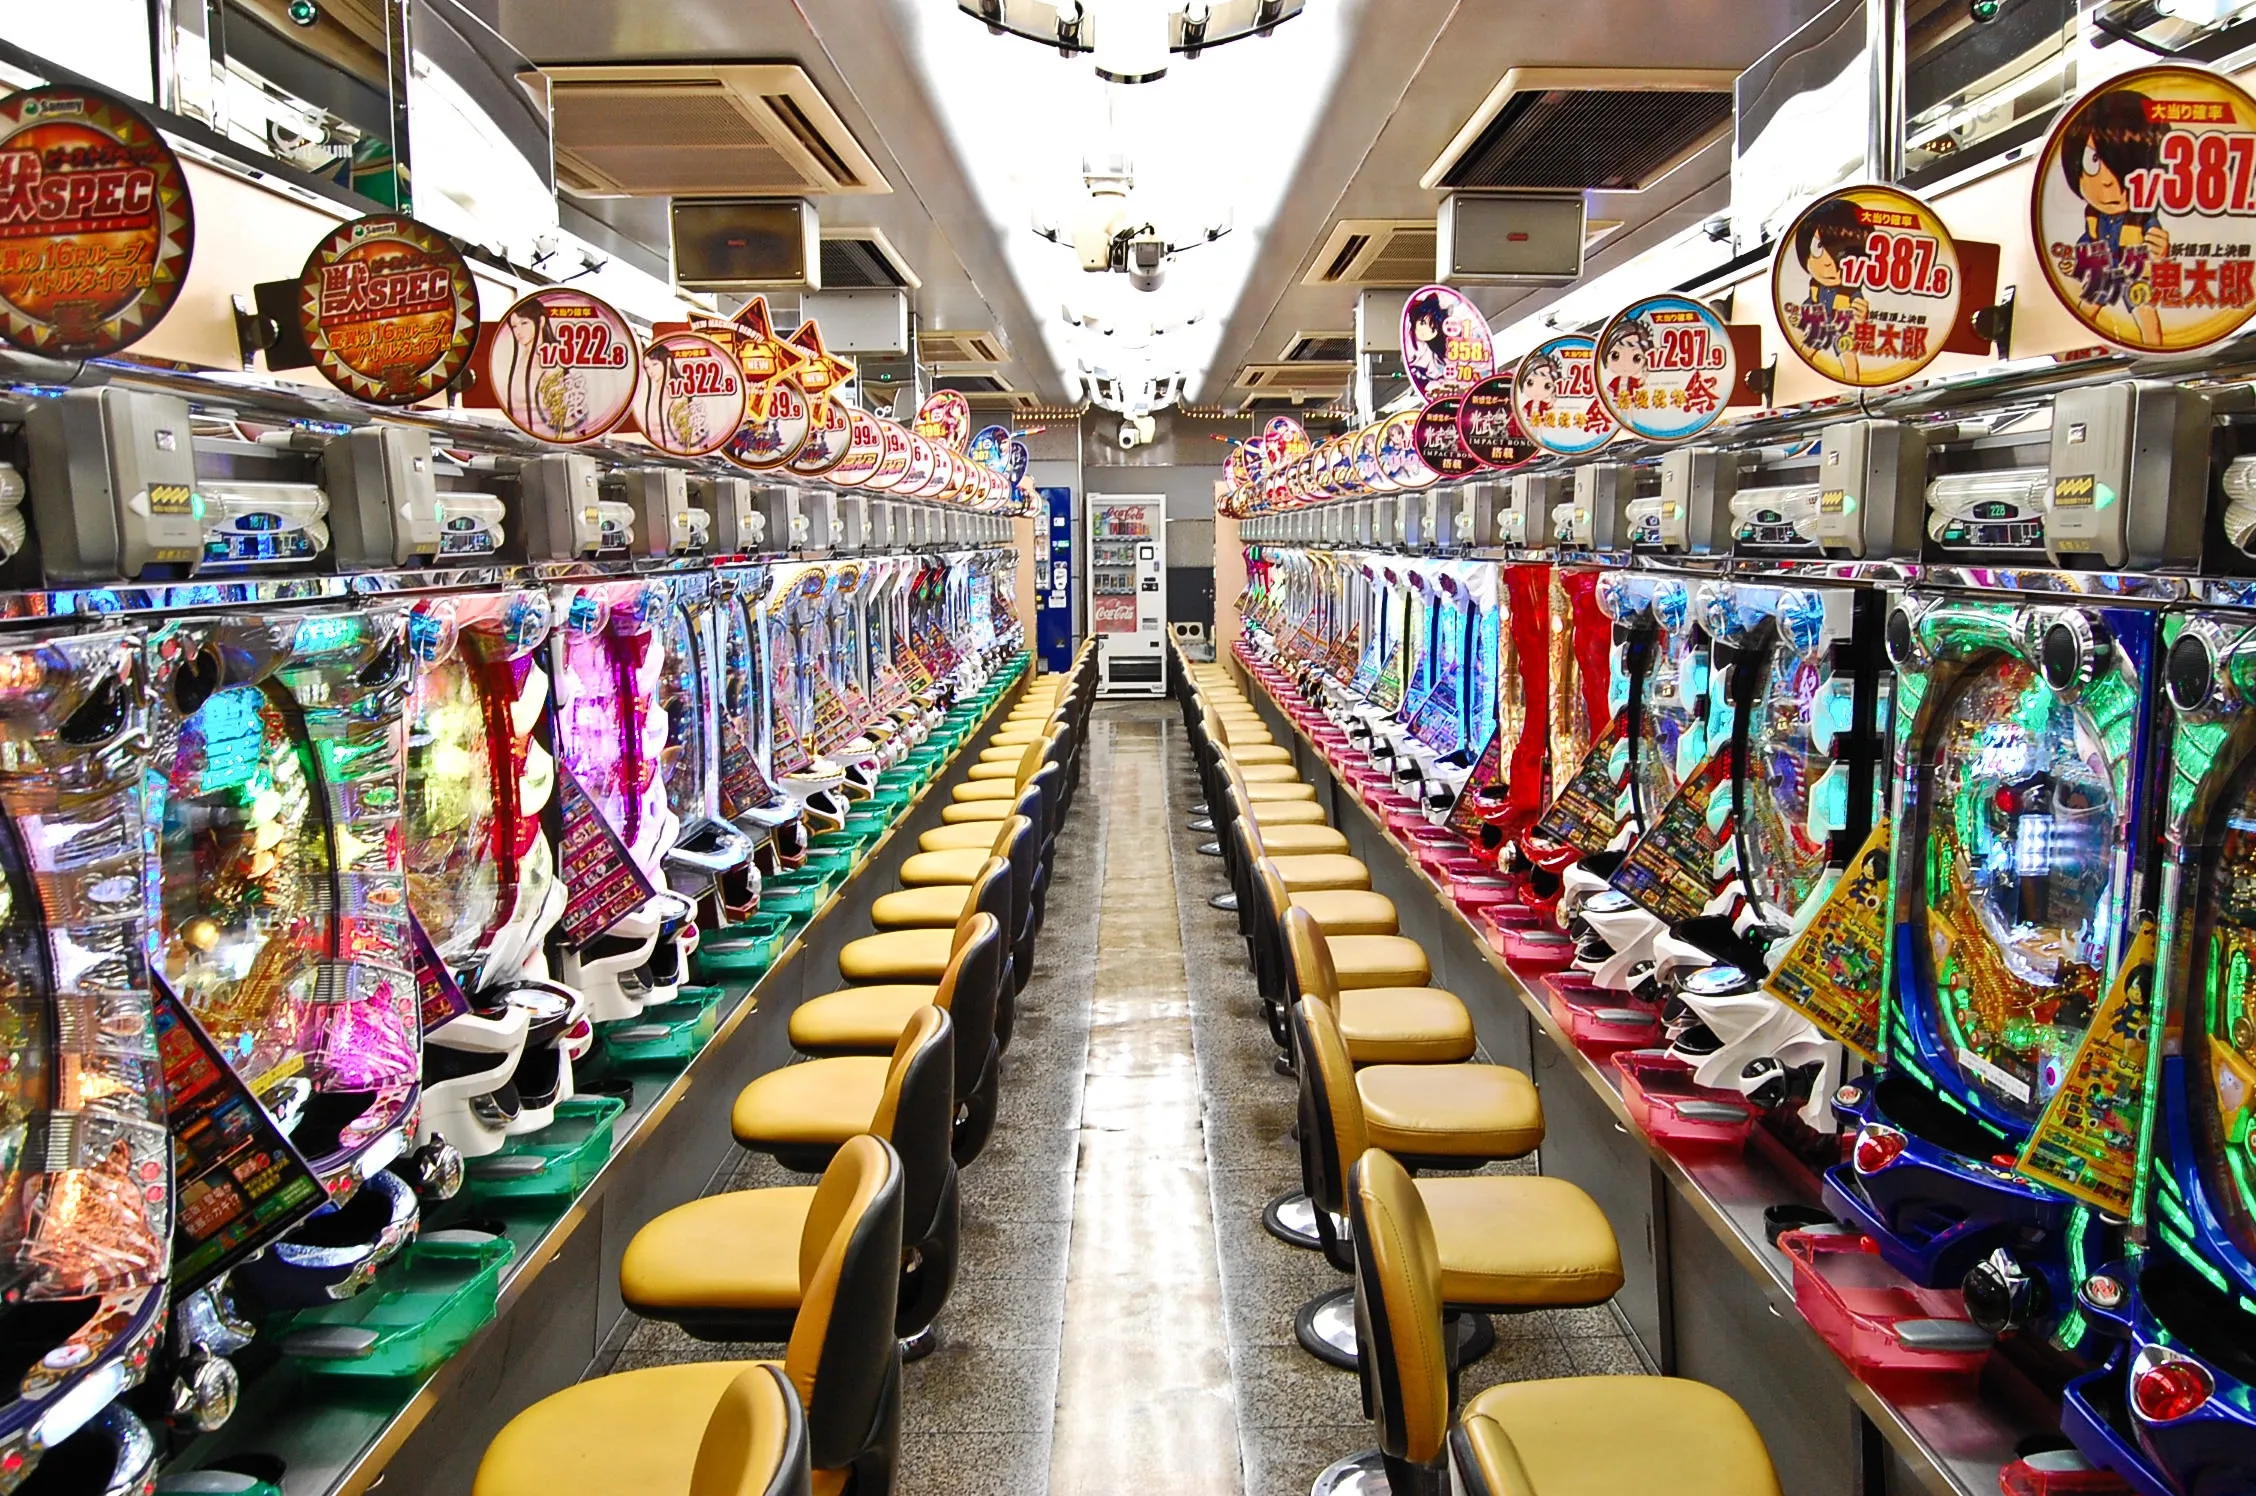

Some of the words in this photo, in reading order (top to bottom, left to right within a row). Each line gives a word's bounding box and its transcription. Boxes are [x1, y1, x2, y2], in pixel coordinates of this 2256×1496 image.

[2152, 104, 2224, 121] 大当り確率
[1861, 211, 1913, 227] 大当り確率
[0, 239, 146, 275] 異の16Rループ
[1842, 233, 1949, 294] 1/387.8
[540, 323, 625, 366] 1/322.8
[1448, 340, 1489, 361] 358.1
[1647, 329, 1723, 369] 1/297.9
[669, 361, 735, 396] 1/322.8
[1556, 364, 1594, 396] 1/29
[1991, 505, 2005, 516] 228
